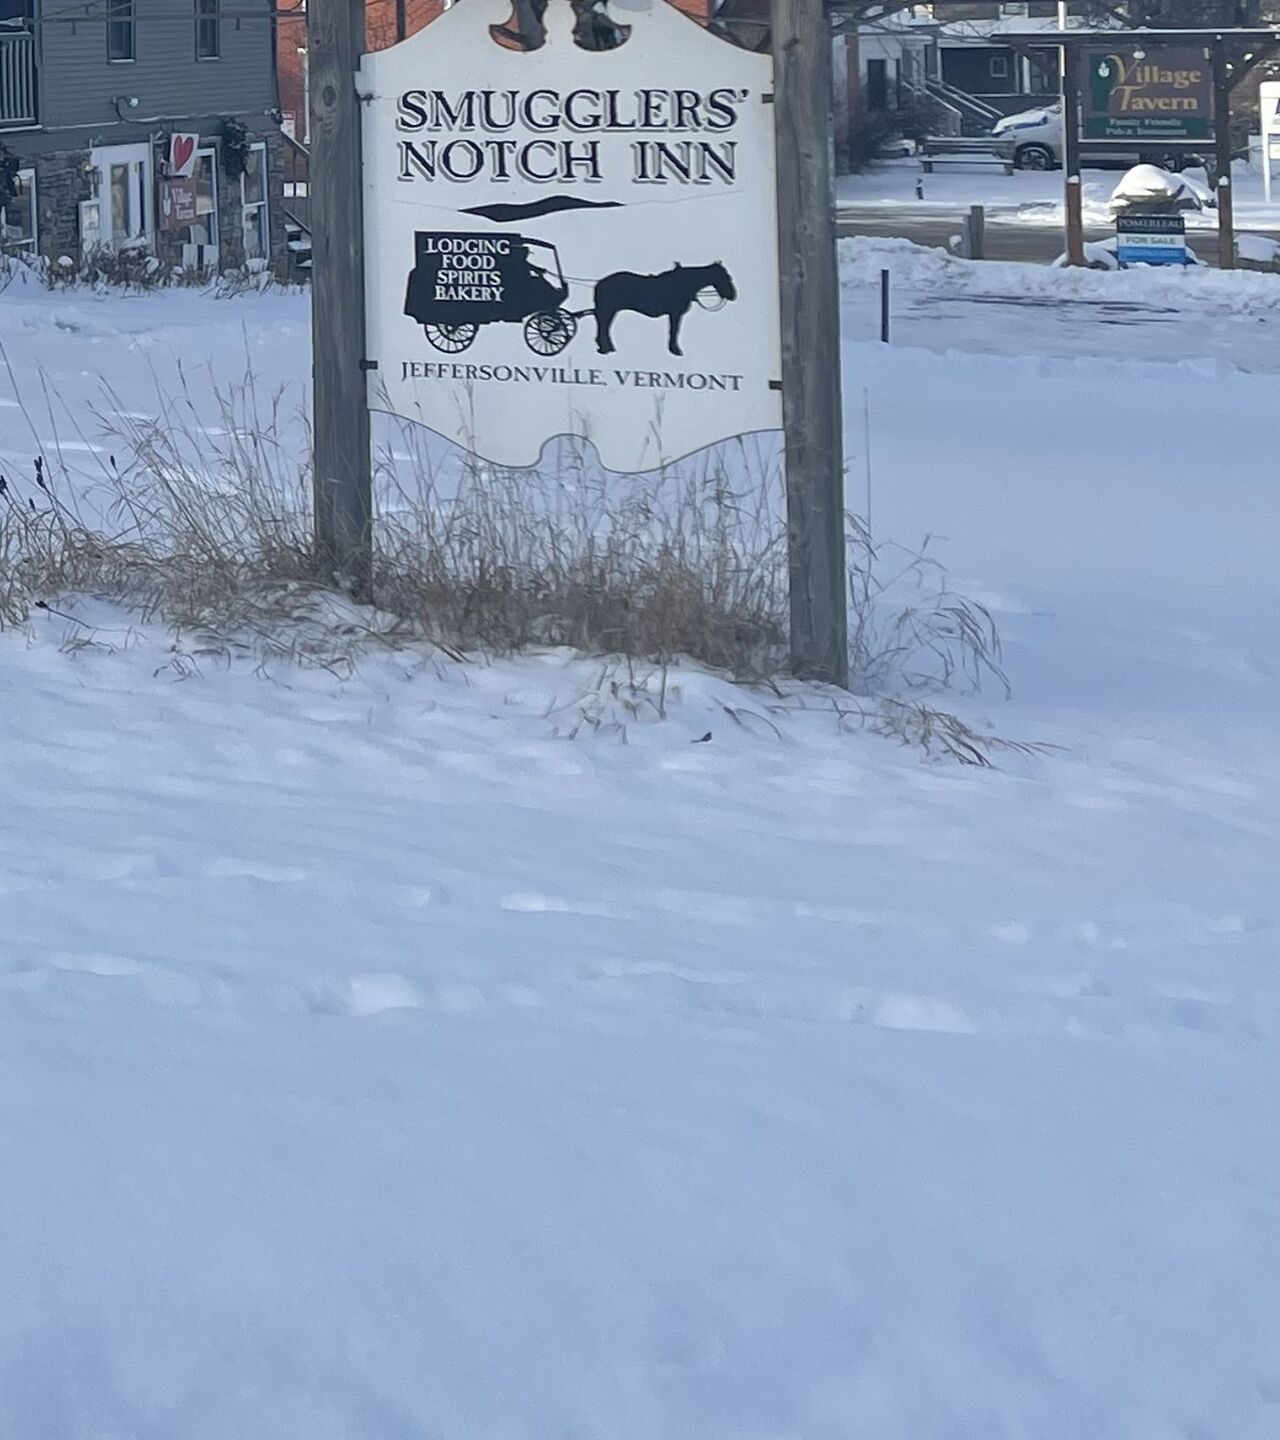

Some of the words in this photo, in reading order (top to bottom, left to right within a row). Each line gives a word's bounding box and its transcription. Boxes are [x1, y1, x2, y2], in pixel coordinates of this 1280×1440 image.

[1105, 54, 1202, 88] Village
[1109, 83, 1198, 111] Tavern
[397, 139, 601, 184] NOTCH
[633, 140, 738, 185] INN
[425, 237, 510, 256] LODGING
[1126, 236, 1147, 244] FOR
[1151, 236, 1176, 245] SALE
[442, 254, 496, 270] FOOD
[437, 269, 501, 286] SPIRITS
[434, 284, 505, 302] BAKERY
[613, 368, 744, 391] VERMONT
